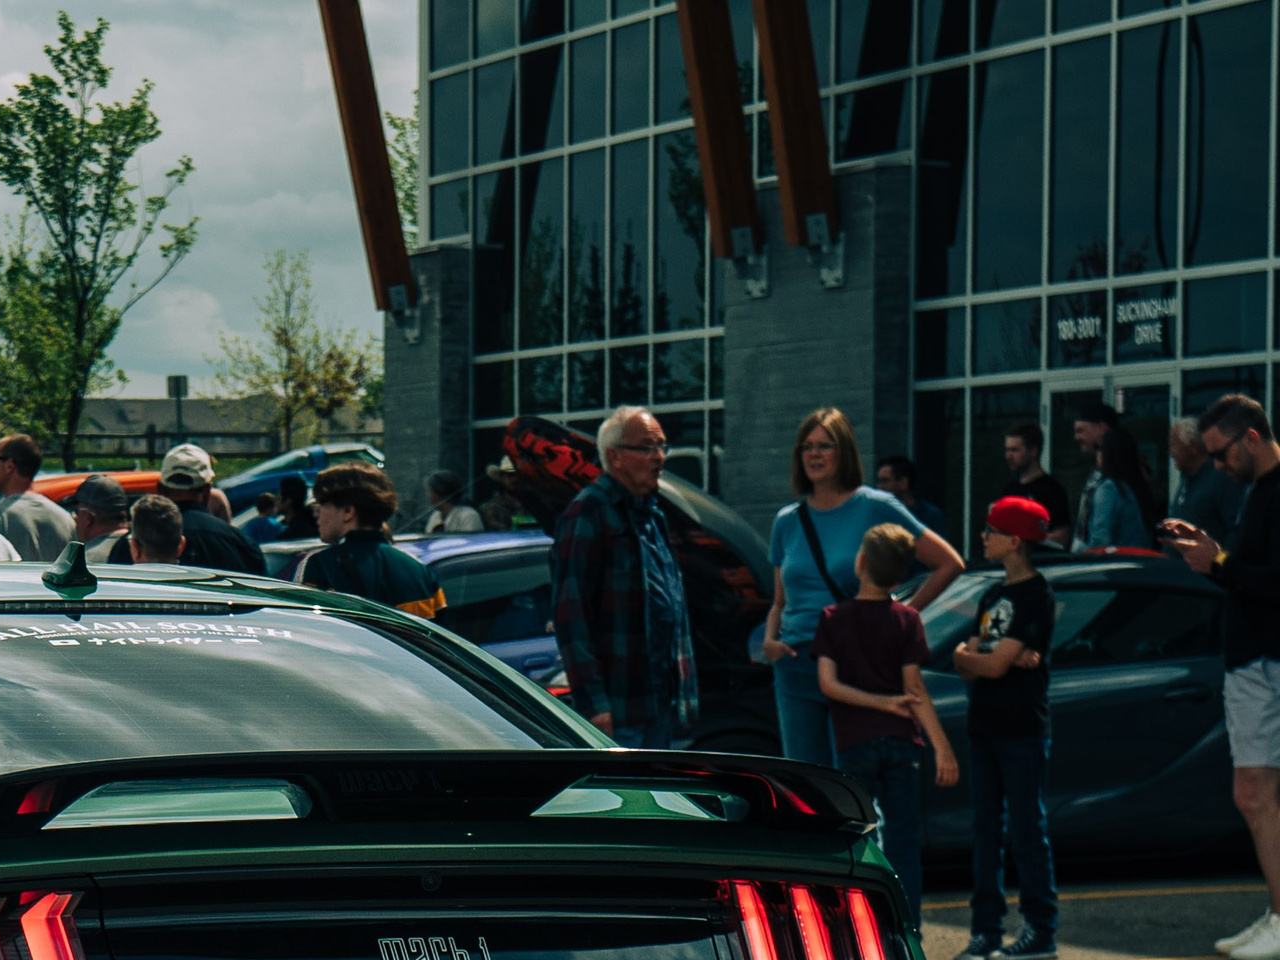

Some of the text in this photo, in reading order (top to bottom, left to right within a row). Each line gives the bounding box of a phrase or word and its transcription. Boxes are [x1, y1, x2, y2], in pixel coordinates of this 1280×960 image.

[1135, 322, 1162, 345] DRIVE
[57, 621, 151, 632] HAIL
[157, 621, 293, 638] SOUTH
[87, 637, 223, 646] ナイトライダー
